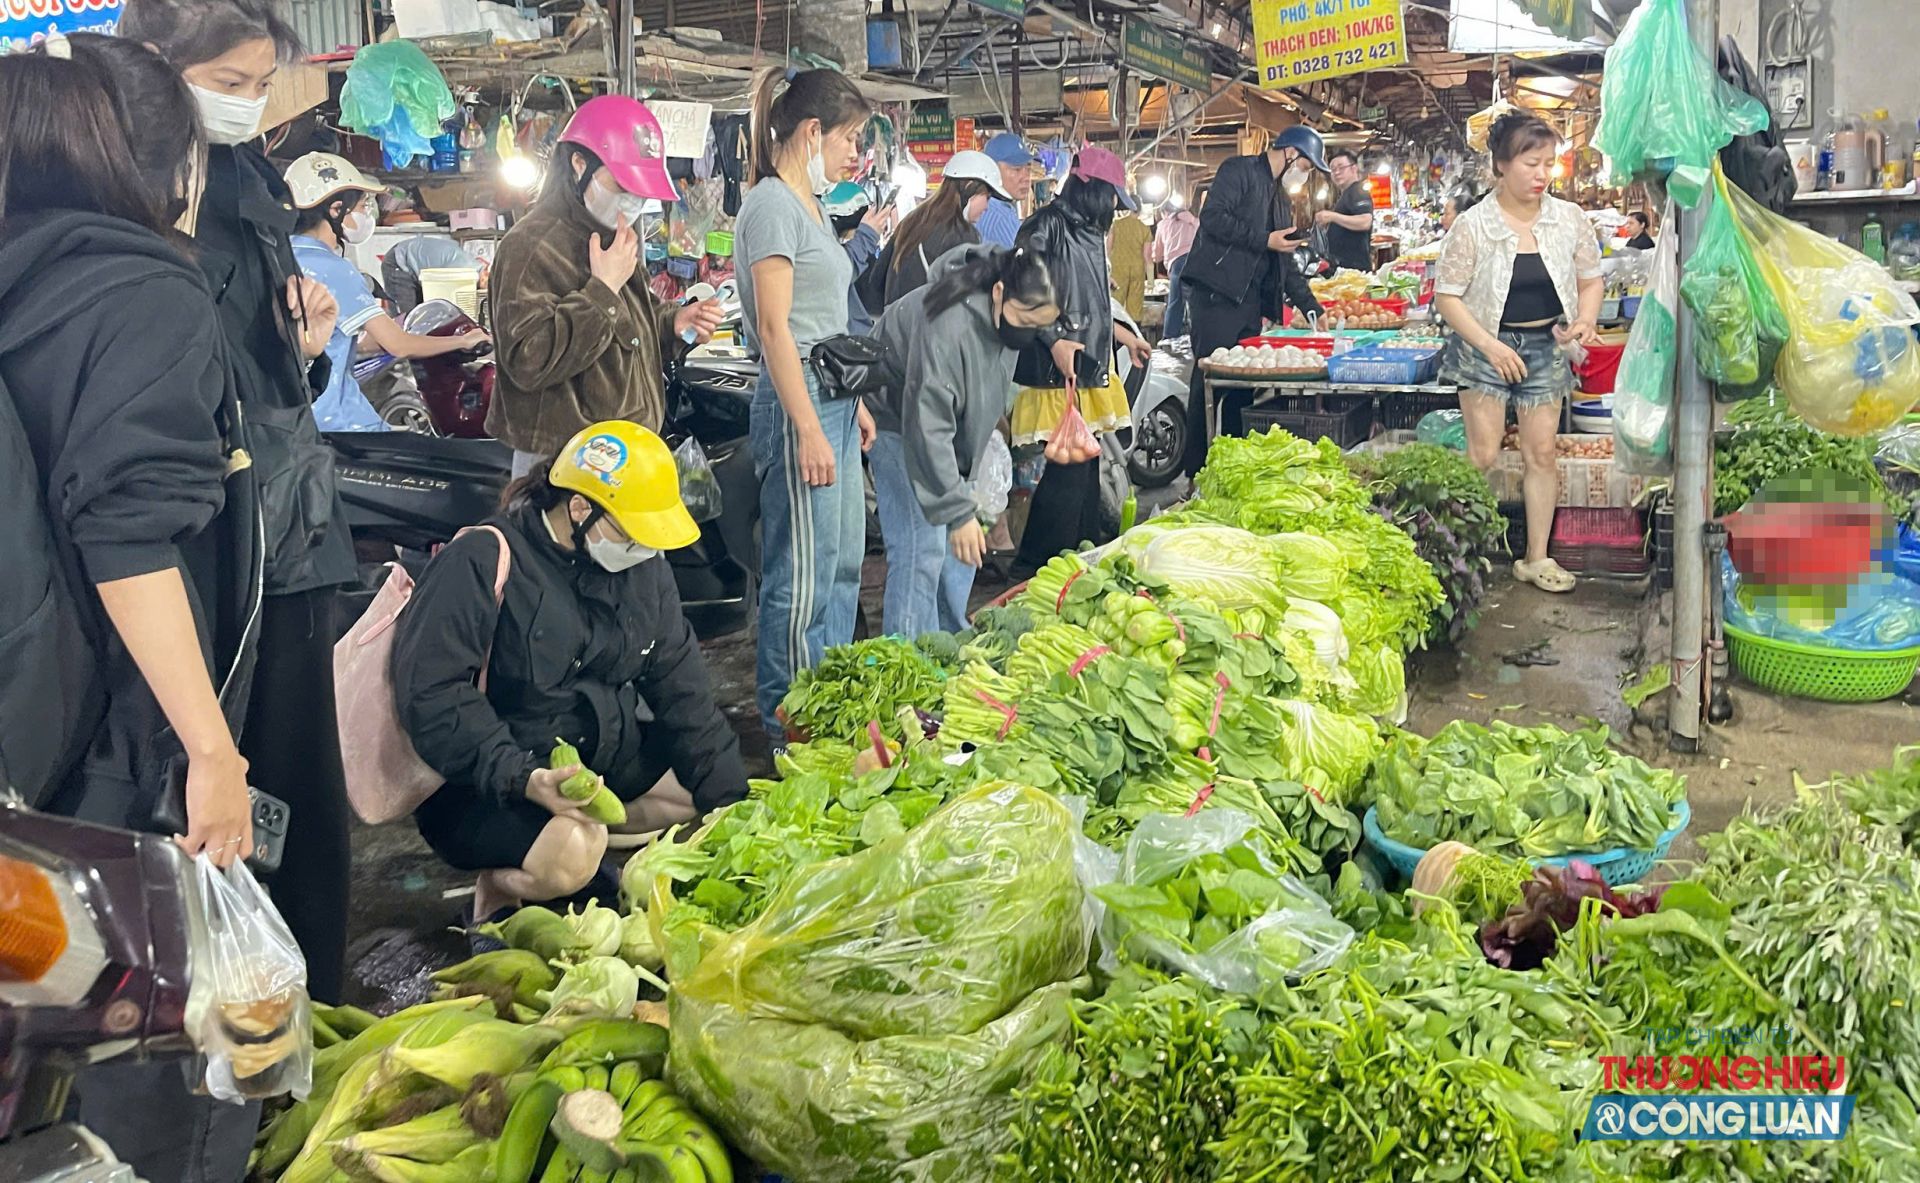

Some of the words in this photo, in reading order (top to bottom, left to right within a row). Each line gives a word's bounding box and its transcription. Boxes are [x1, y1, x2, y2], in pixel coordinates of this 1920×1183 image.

[1263, 31, 1306, 58] THẠCH
[1345, 14, 1395, 40] 10K/KG
[1293, 55, 1330, 75] 0328
[1334, 47, 1364, 67] 732
[1369, 41, 1396, 60] 421
